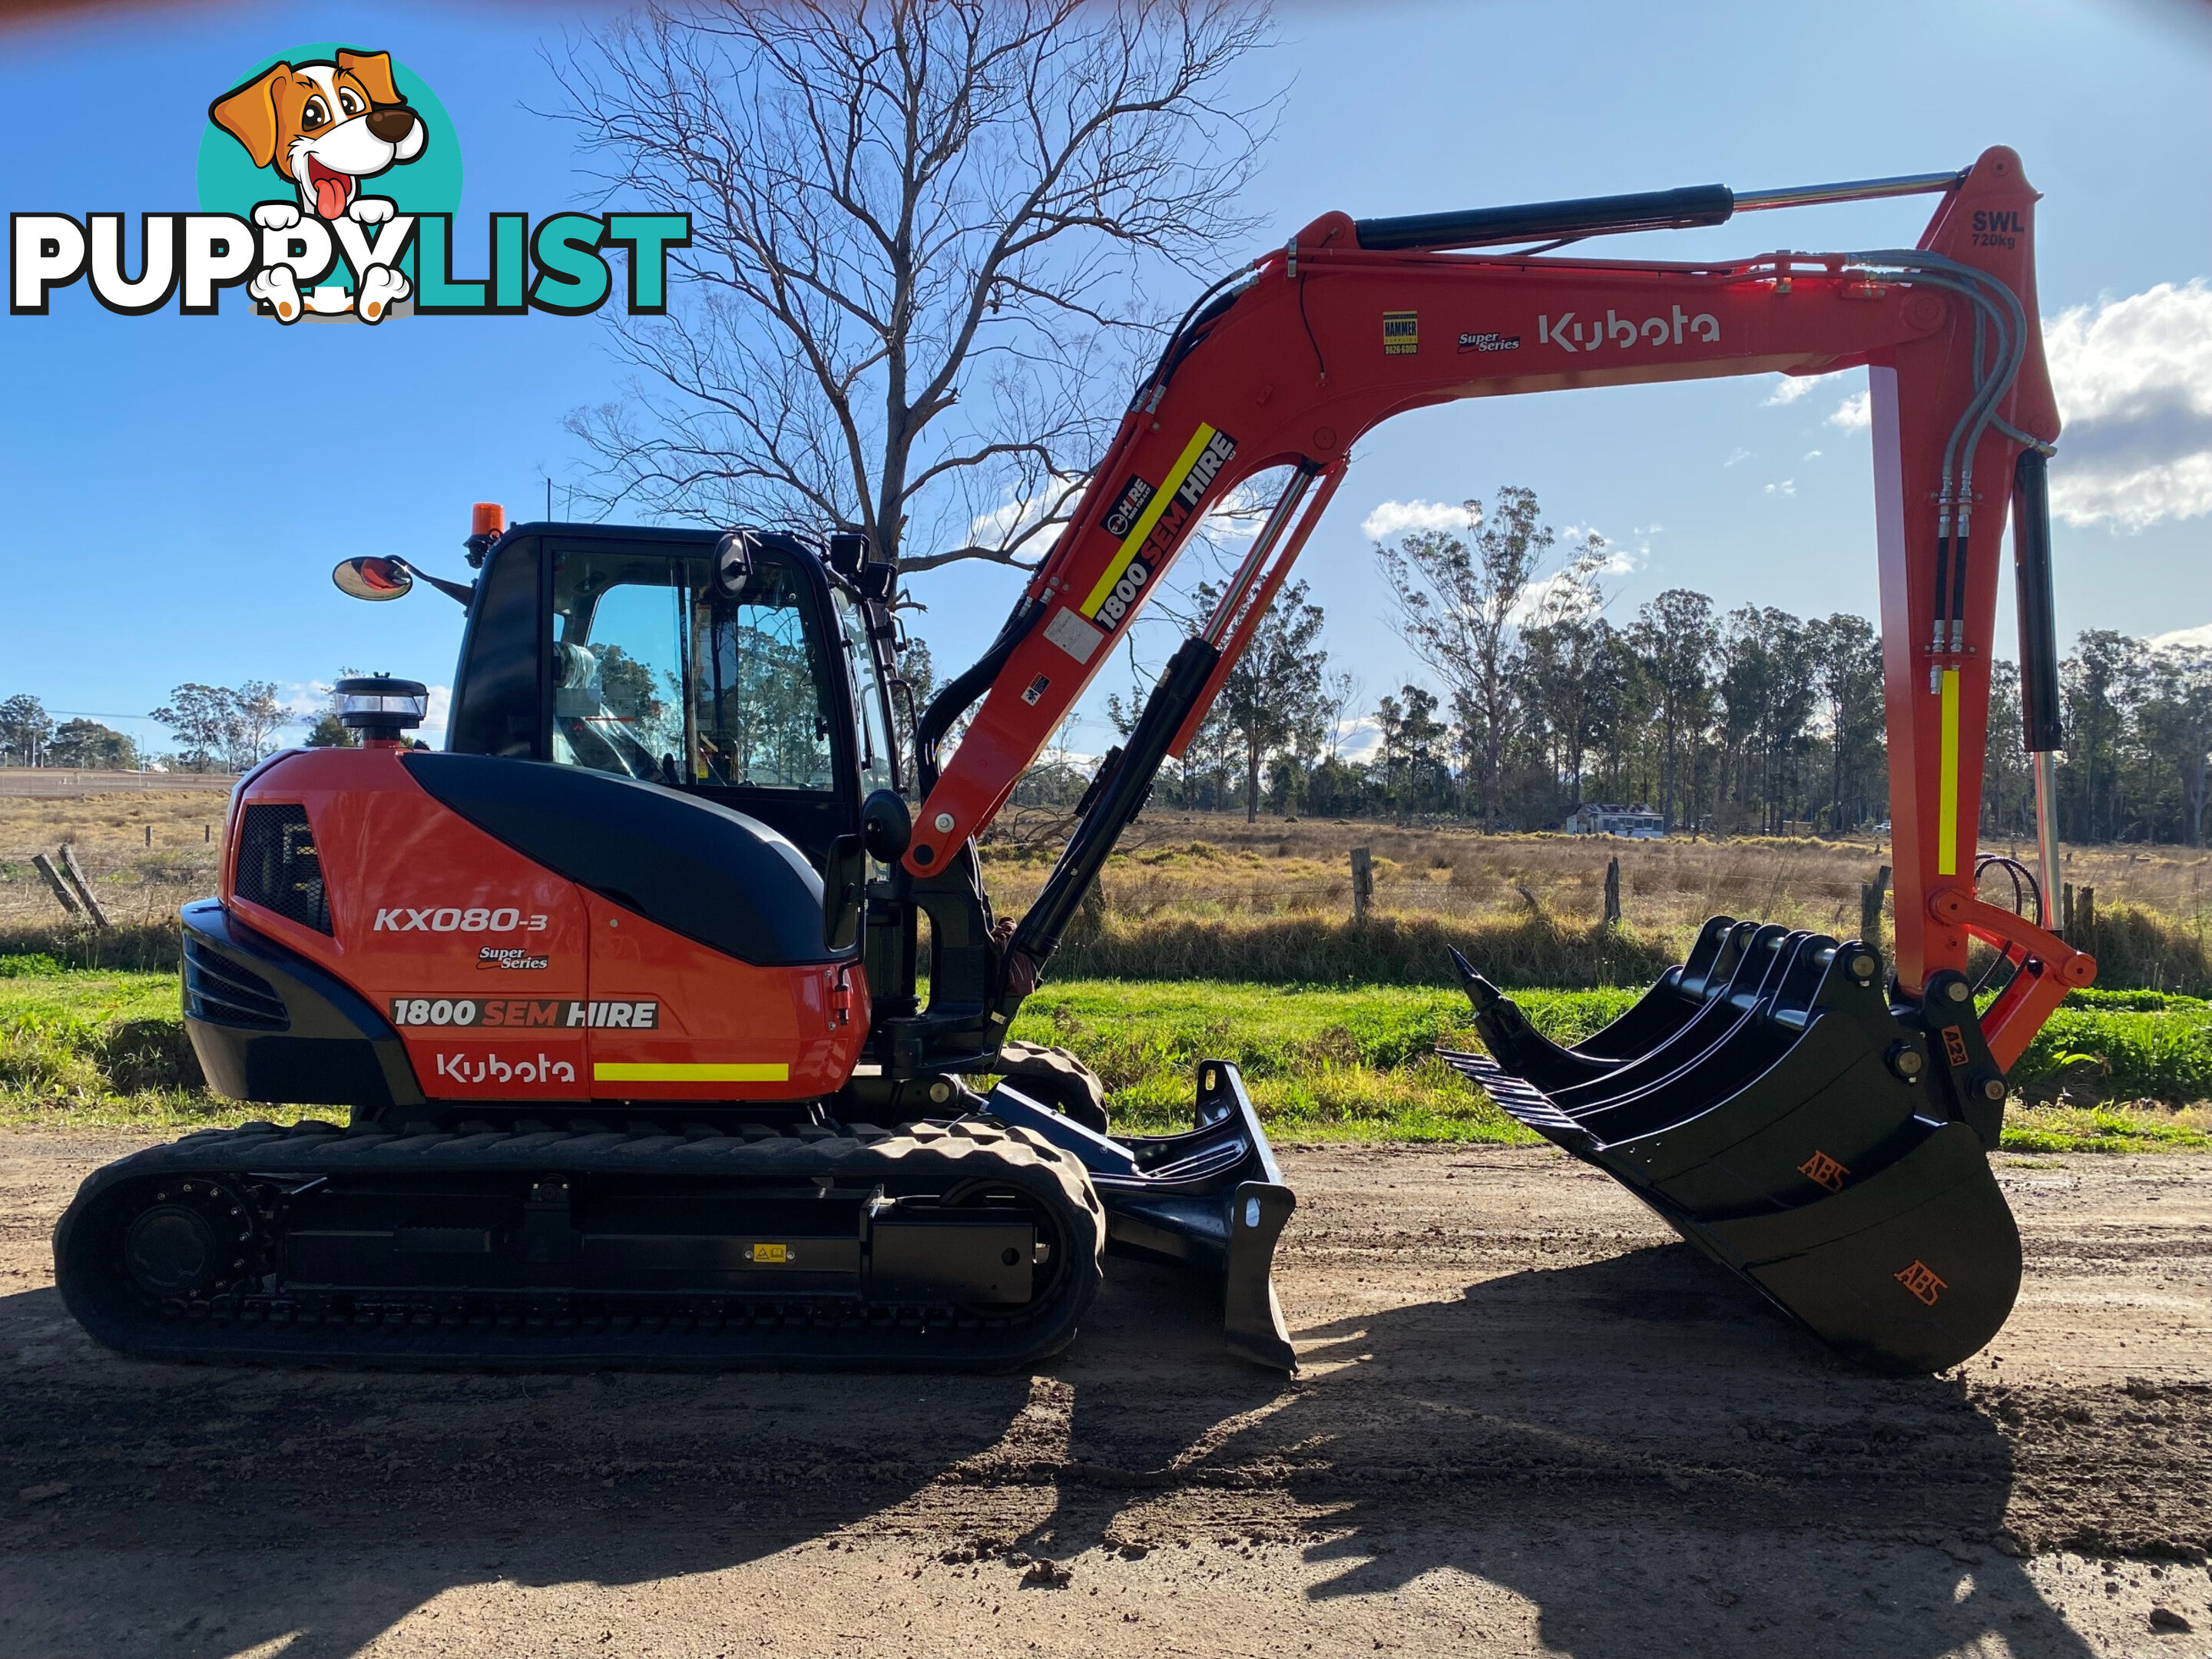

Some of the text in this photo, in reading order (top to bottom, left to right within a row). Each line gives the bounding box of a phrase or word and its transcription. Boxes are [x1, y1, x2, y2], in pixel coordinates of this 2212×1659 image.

[1972, 210, 2024, 232] SWL
[1972, 233, 2015, 250] 720kg
[1385, 320, 1416, 337] HAMMER
[1538, 304, 1720, 353] Kubota
[1459, 333, 1499, 349] Super
[1479, 339, 1519, 353] Series
[1118, 478, 1147, 517] HIRE
[1096, 431, 1234, 630] 1800 SEM HIRE
[373, 908, 548, 932] KX080-3
[478, 946, 525, 962] Super
[500, 957, 548, 969] Series
[394, 999, 657, 1028] 1800 SEM HIRE
[436, 1053, 575, 1083] Kubota
[1796, 1150, 1850, 1192] ABS
[1893, 1259, 1949, 1306] ABS
